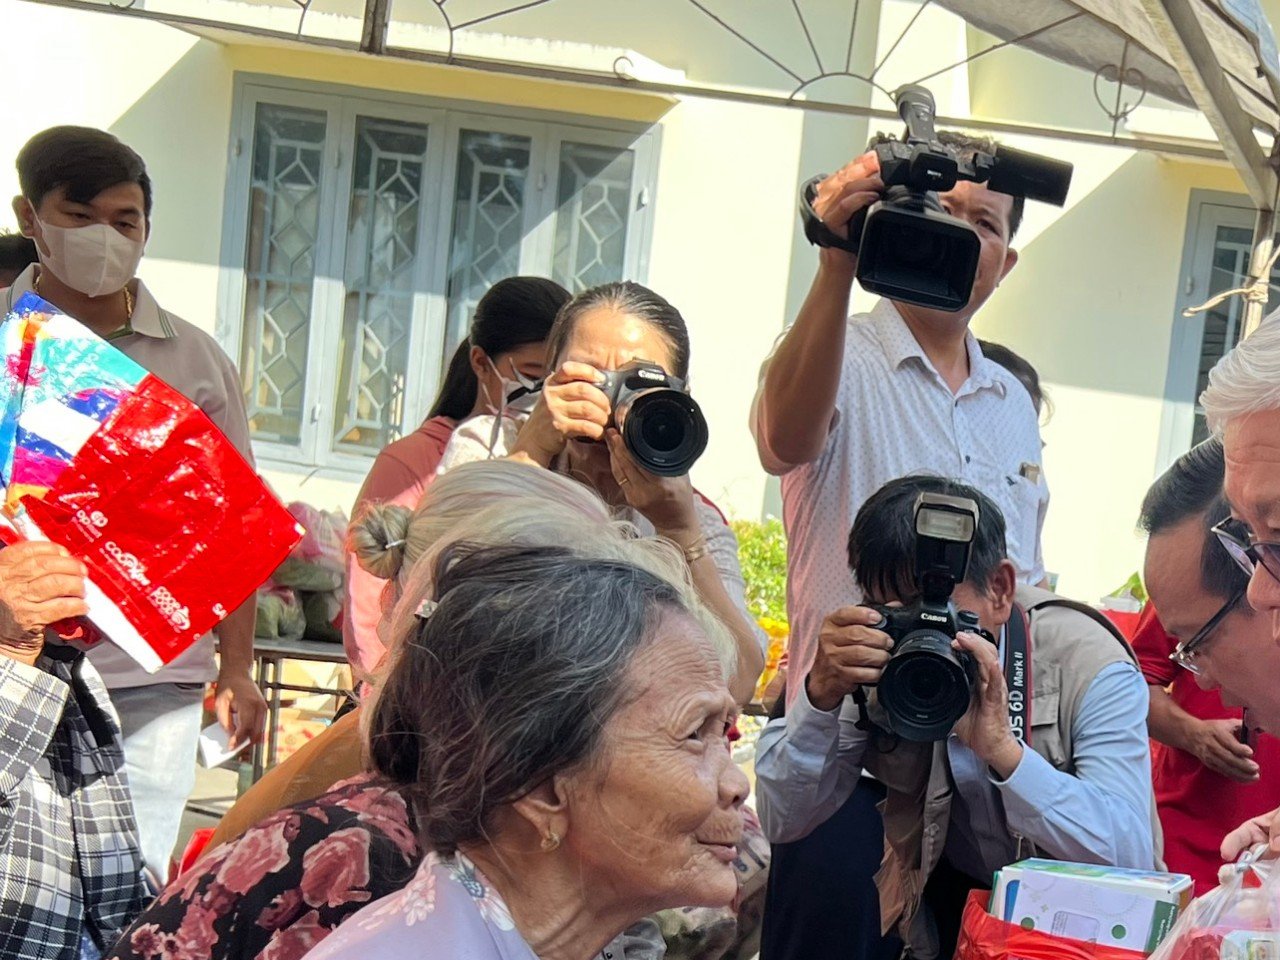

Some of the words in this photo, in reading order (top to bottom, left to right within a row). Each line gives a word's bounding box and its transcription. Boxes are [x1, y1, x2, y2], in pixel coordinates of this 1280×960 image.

[921, 613, 947, 622] Canon
[1013, 660, 1023, 686] Mark
[1009, 690, 1023, 711] 6D
